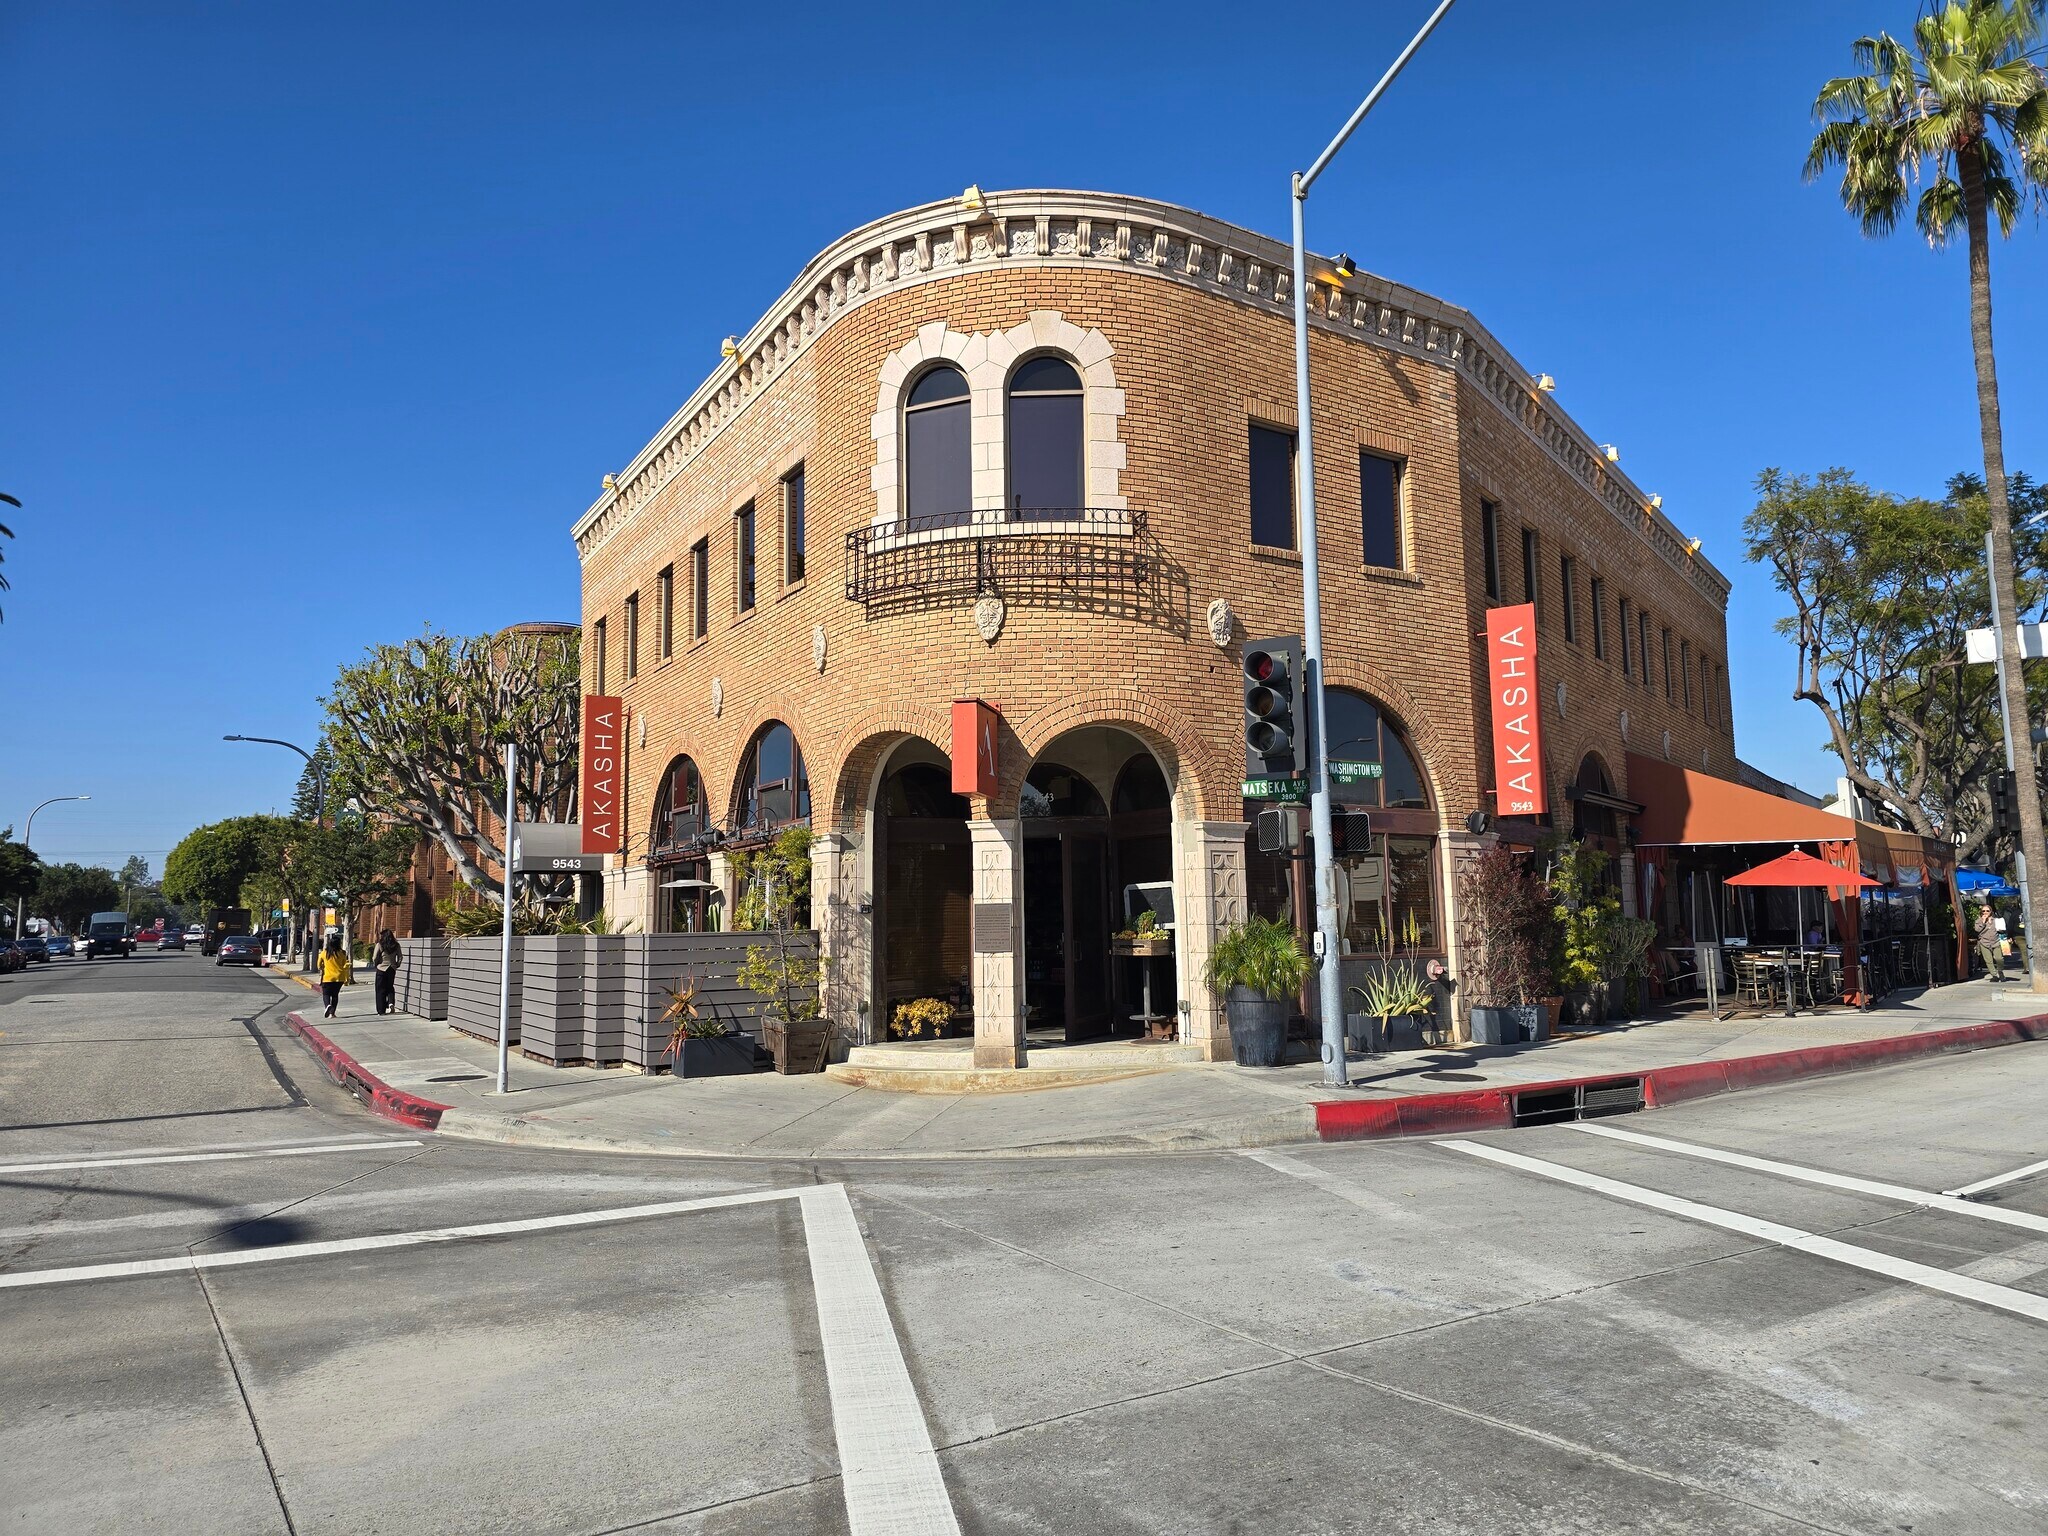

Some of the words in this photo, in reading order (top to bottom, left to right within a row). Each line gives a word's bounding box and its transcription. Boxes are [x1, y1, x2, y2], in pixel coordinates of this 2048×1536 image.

[1499, 626, 1533, 794] AKASHA
[592, 712, 614, 839] AKASHA
[1328, 763, 1371, 775] WASHINGTON
[1241, 781, 1287, 795] WATSEKA
[1511, 801, 1533, 812] 9543
[552, 859, 581, 869] 9543
